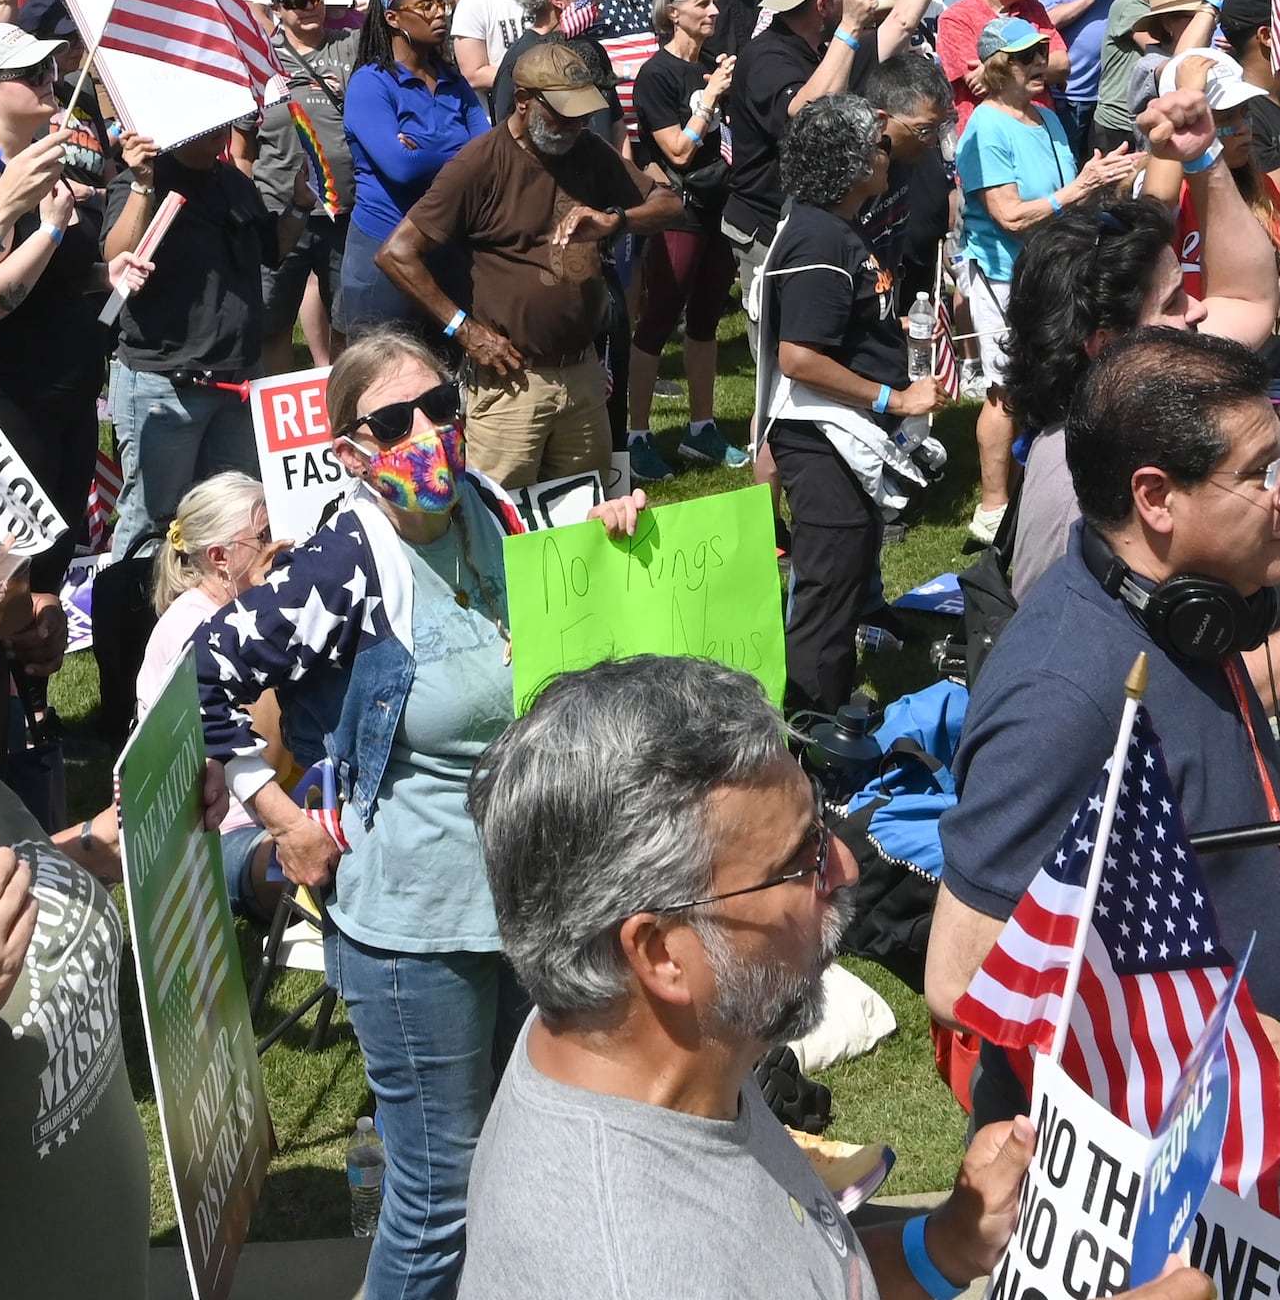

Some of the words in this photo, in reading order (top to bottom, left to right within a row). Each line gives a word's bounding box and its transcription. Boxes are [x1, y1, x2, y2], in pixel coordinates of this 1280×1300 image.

[6, 476, 57, 538] NO
[541, 535, 590, 616] No
[626, 511, 724, 593] Kings
[670, 581, 764, 673] News
[1191, 612, 1213, 646] TASCAM
[132, 800, 157, 890] ONE
[154, 724, 200, 838] NATION
[39, 1104, 70, 1137] SOLDIERS
[188, 1022, 236, 1165] UNDER
[1035, 1092, 1077, 1189] NO
[1148, 1056, 1214, 1217] PEOPLE
[193, 1065, 259, 1272] DISTRESS
[1169, 1191, 1191, 1242] ACLU
[1014, 1173, 1058, 1270] NO
